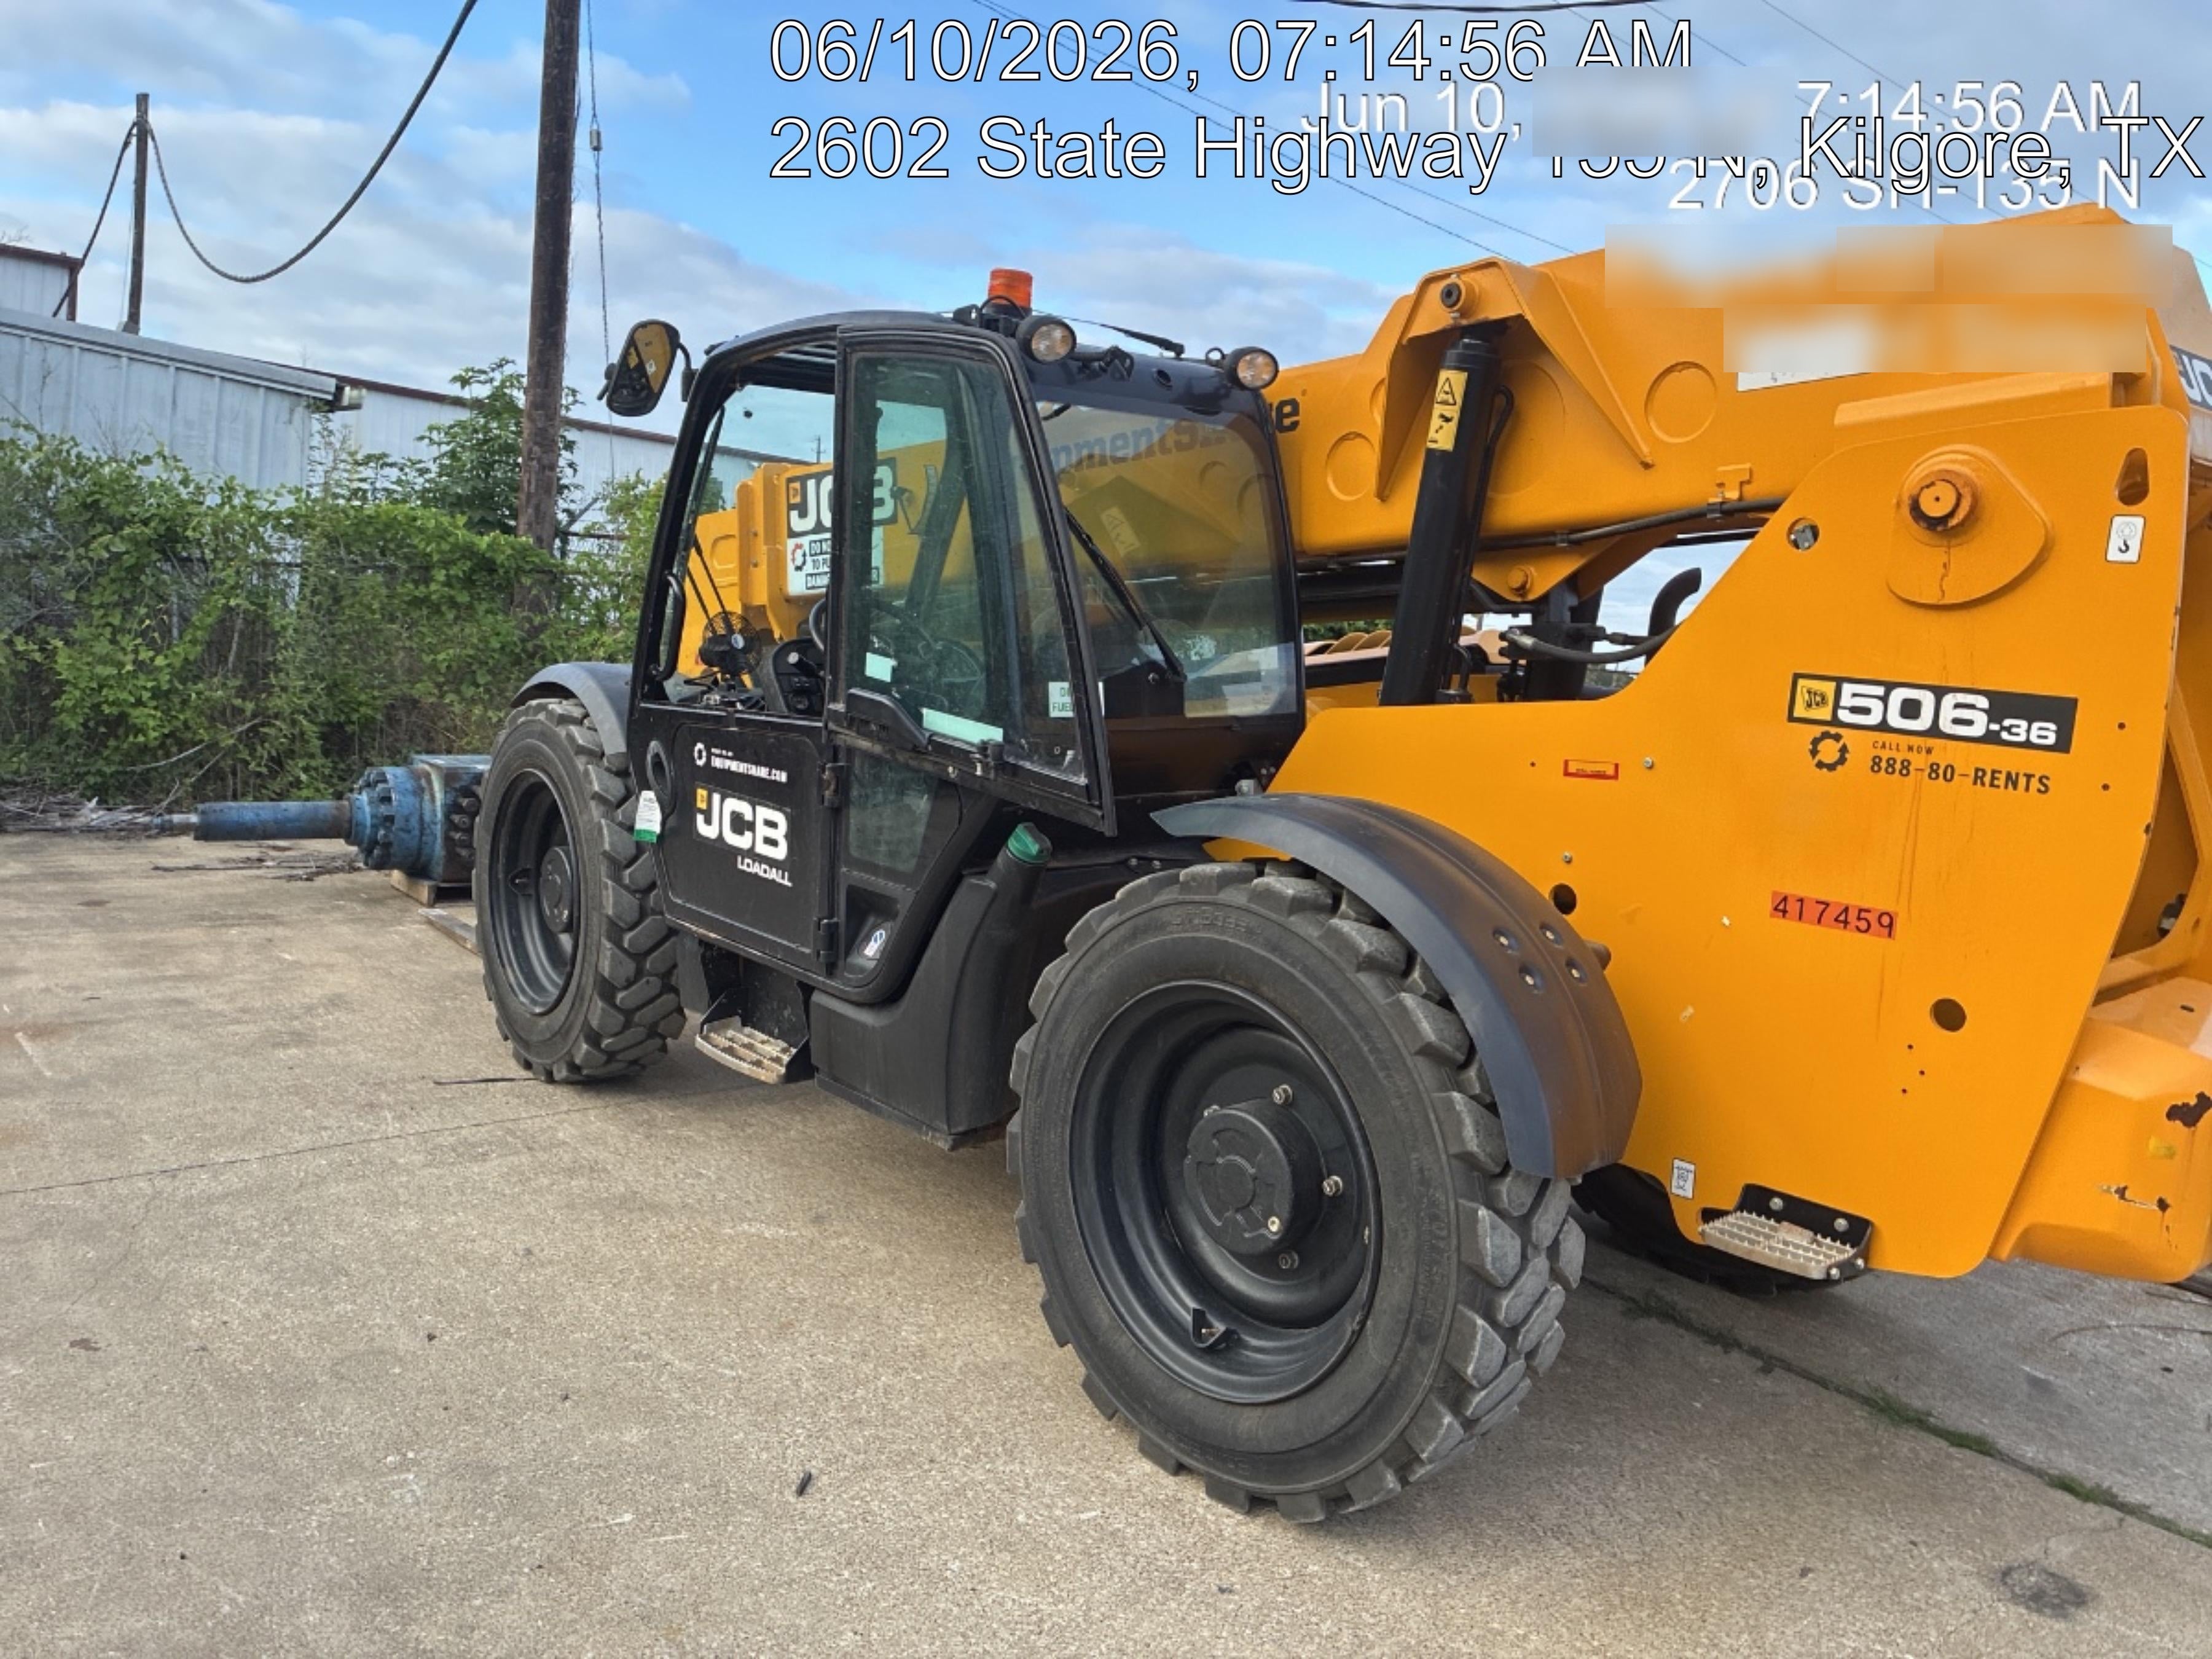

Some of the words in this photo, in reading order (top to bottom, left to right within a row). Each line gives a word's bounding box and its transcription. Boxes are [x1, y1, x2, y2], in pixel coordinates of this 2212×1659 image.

[1837, 682, 2058, 746] 506-36
[1872, 740, 1901, 753] CALL
[1907, 744, 1934, 755] NOW
[1870, 755, 2051, 794] 888-80-RENTS
[696, 791, 788, 861] JCB
[737, 855, 794, 887] LOADALL
[1773, 895, 1894, 939] 417459
